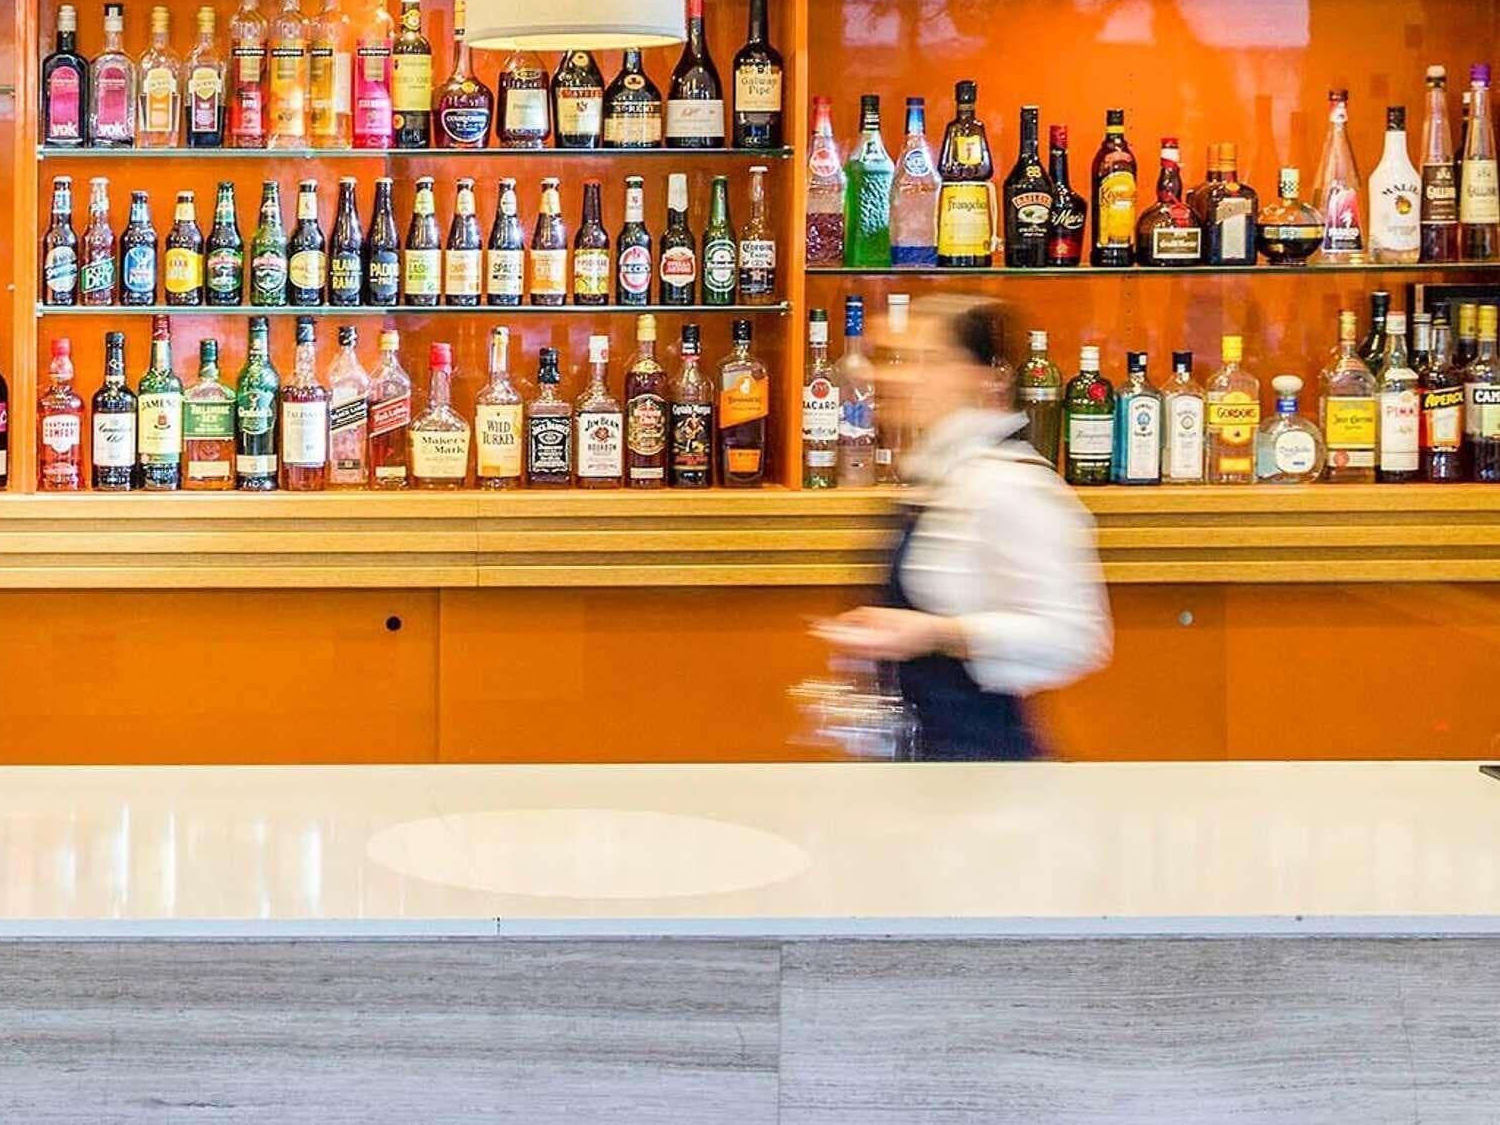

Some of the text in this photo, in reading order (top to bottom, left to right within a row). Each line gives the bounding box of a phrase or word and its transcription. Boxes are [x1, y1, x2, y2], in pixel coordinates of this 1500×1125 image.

[743, 242, 773, 252] Corona
[486, 420, 511, 433] WILD
[584, 419, 599, 432] JIM
[422, 435, 466, 445] Maker's
[483, 432, 515, 445] TURKEY
[434, 444, 462, 454] Mark
